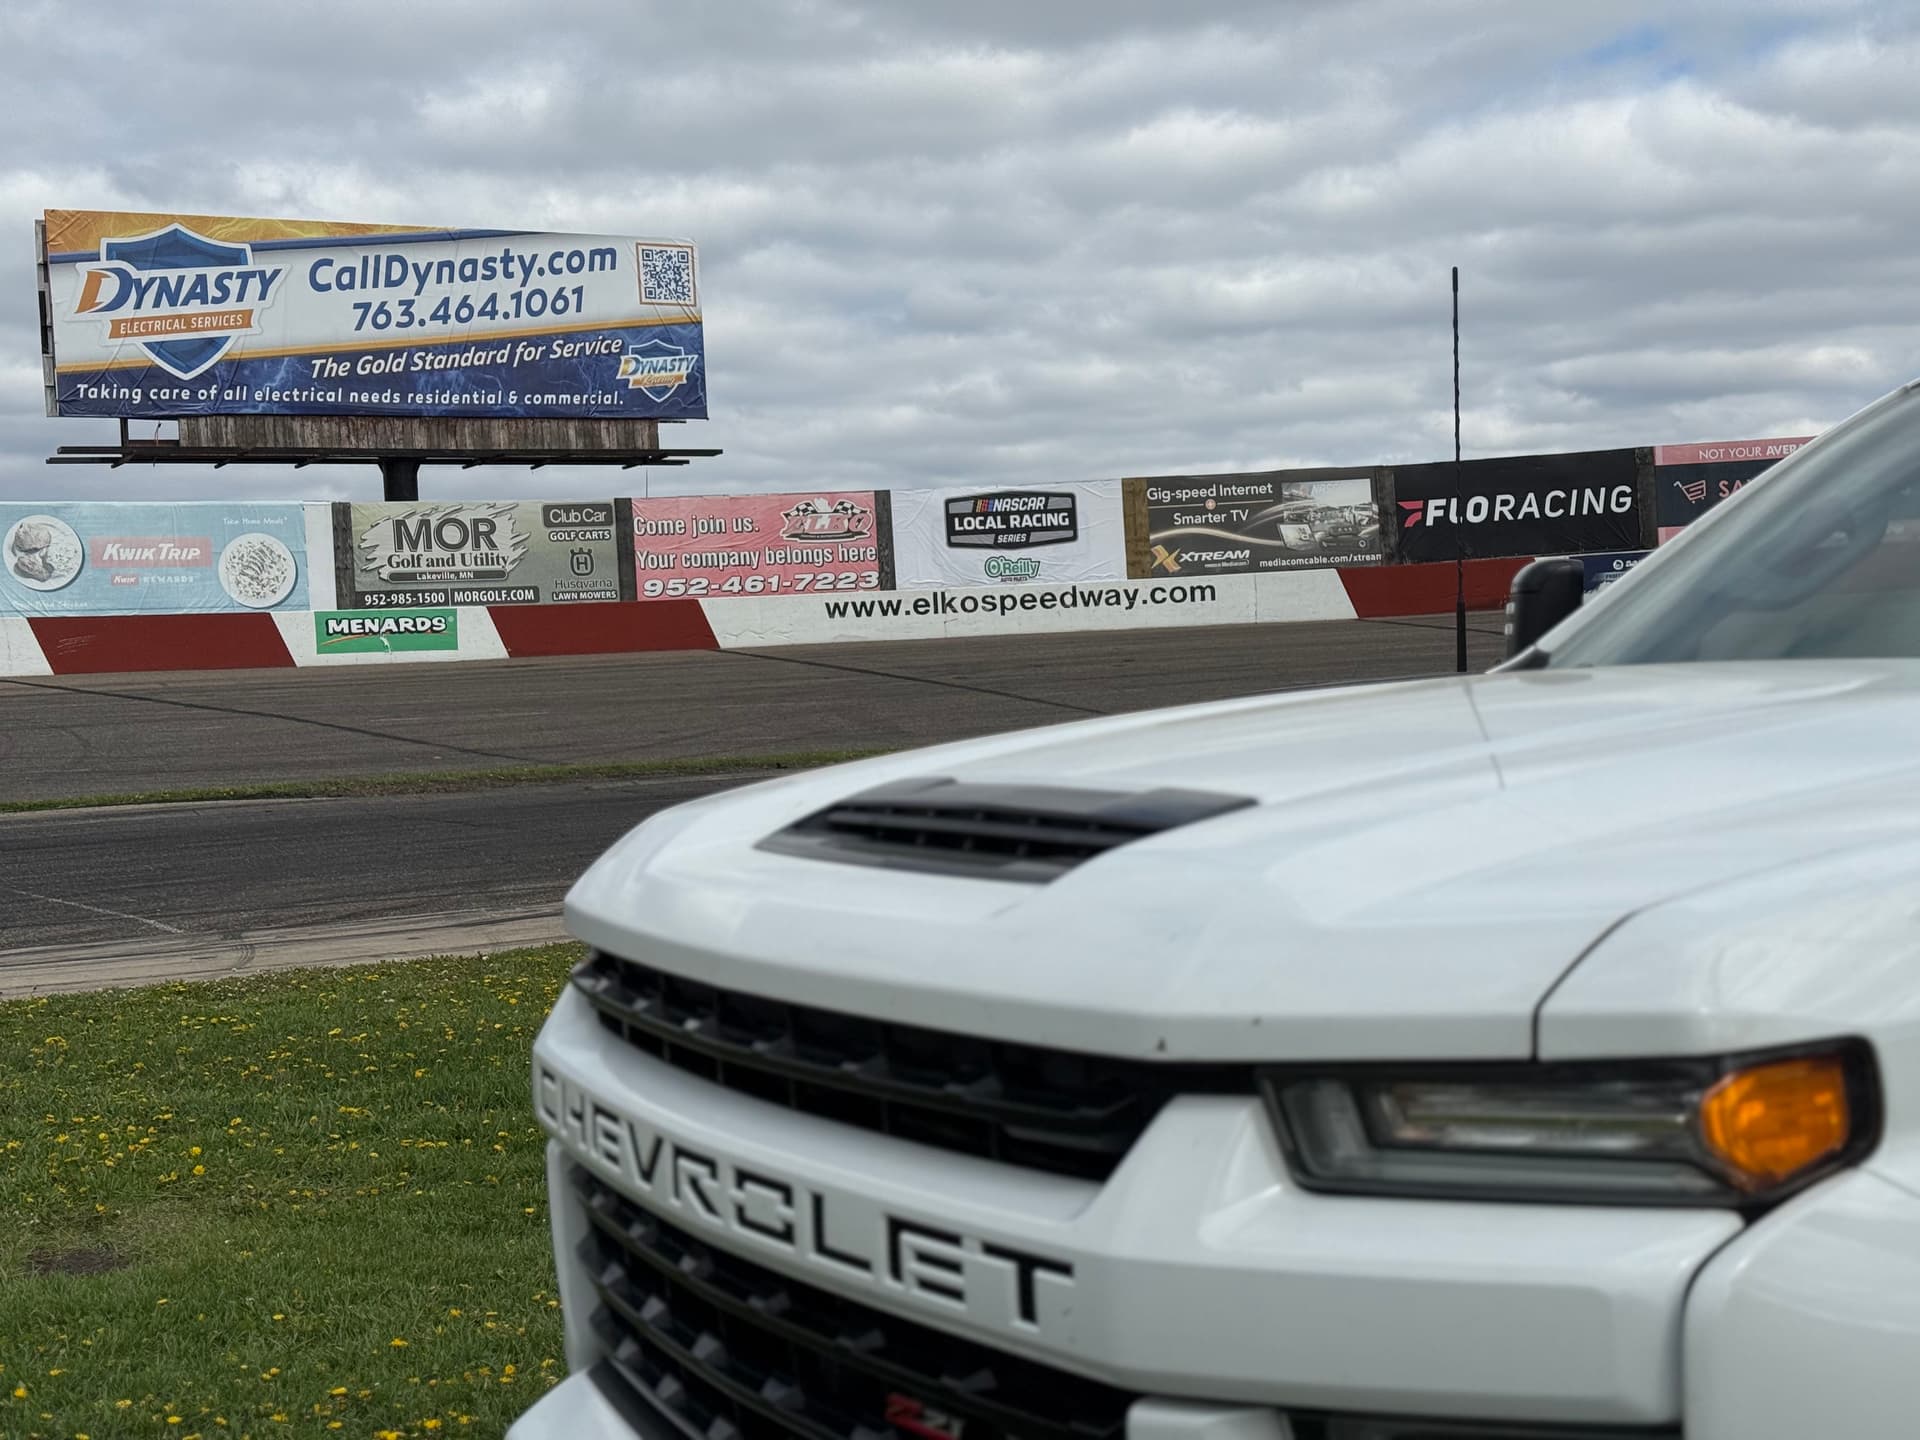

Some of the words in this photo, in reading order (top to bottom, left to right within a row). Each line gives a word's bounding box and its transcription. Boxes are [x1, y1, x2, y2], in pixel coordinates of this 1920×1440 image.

[309, 248, 617, 296] CallDynasty.com
[75, 266, 283, 315] DYNASTY
[353, 286, 584, 331] 763.464.1061
[120, 319, 187, 334] ELECTRICAL
[190, 314, 243, 329] SERVICES
[310, 358, 349, 379] The
[356, 351, 404, 377] Gold
[411, 345, 511, 372] Standard
[514, 344, 546, 367] for
[549, 335, 623, 358] Service
[76, 383, 142, 403] Taking
[150, 386, 190, 400] care
[199, 385, 217, 401] of
[223, 385, 247, 401] all
[254, 387, 342, 402] electrical
[350, 389, 401, 404] needs
[407, 391, 502, 405] residential
[508, 392, 518, 404] &
[524, 390, 624, 406] commercial.
[1699, 448, 1725, 460] NOT
[1729, 446, 1762, 458] YOUR
[1146, 484, 1216, 502] Gig-speed
[1219, 483, 1273, 497] Internet
[992, 497, 1046, 512] NASCAR
[1425, 484, 1633, 526] FLORACING
[549, 508, 580, 524] Club
[581, 507, 607, 523] Car
[633, 515, 686, 537] Come
[692, 513, 727, 538] join
[732, 512, 760, 533] us.
[954, 513, 1006, 532] LOCAL
[1010, 511, 1070, 529] RACING
[1173, 512, 1226, 525] Smarter
[1230, 509, 1249, 522] TV
[391, 517, 500, 552] MOR
[549, 529, 577, 542] GOLF
[578, 528, 611, 541] CARTS
[997, 533, 1028, 544] SERIES
[387, 553, 423, 568] Golf
[426, 553, 456, 567] and
[459, 552, 510, 569] Utility
[637, 549, 676, 570] Your
[681, 550, 760, 570] company
[765, 545, 834, 568] belongs
[838, 542, 877, 562] here
[1179, 549, 1250, 563] XTREAM
[416, 572, 458, 581] Lakeville,
[459, 571, 475, 580] MN
[554, 579, 613, 593] Husqvarna
[643, 571, 880, 597] 952-461-7223
[364, 592, 446, 606] 952-985-1500
[453, 588, 535, 603] MORGOLF.COM
[553, 590, 581, 601] LAWN
[583, 588, 617, 600] MOWERS
[825, 584, 1217, 618] www.elkospeedway.com
[327, 614, 448, 636] MENARDS
[538, 1069, 1074, 1328] CHEVROLET
